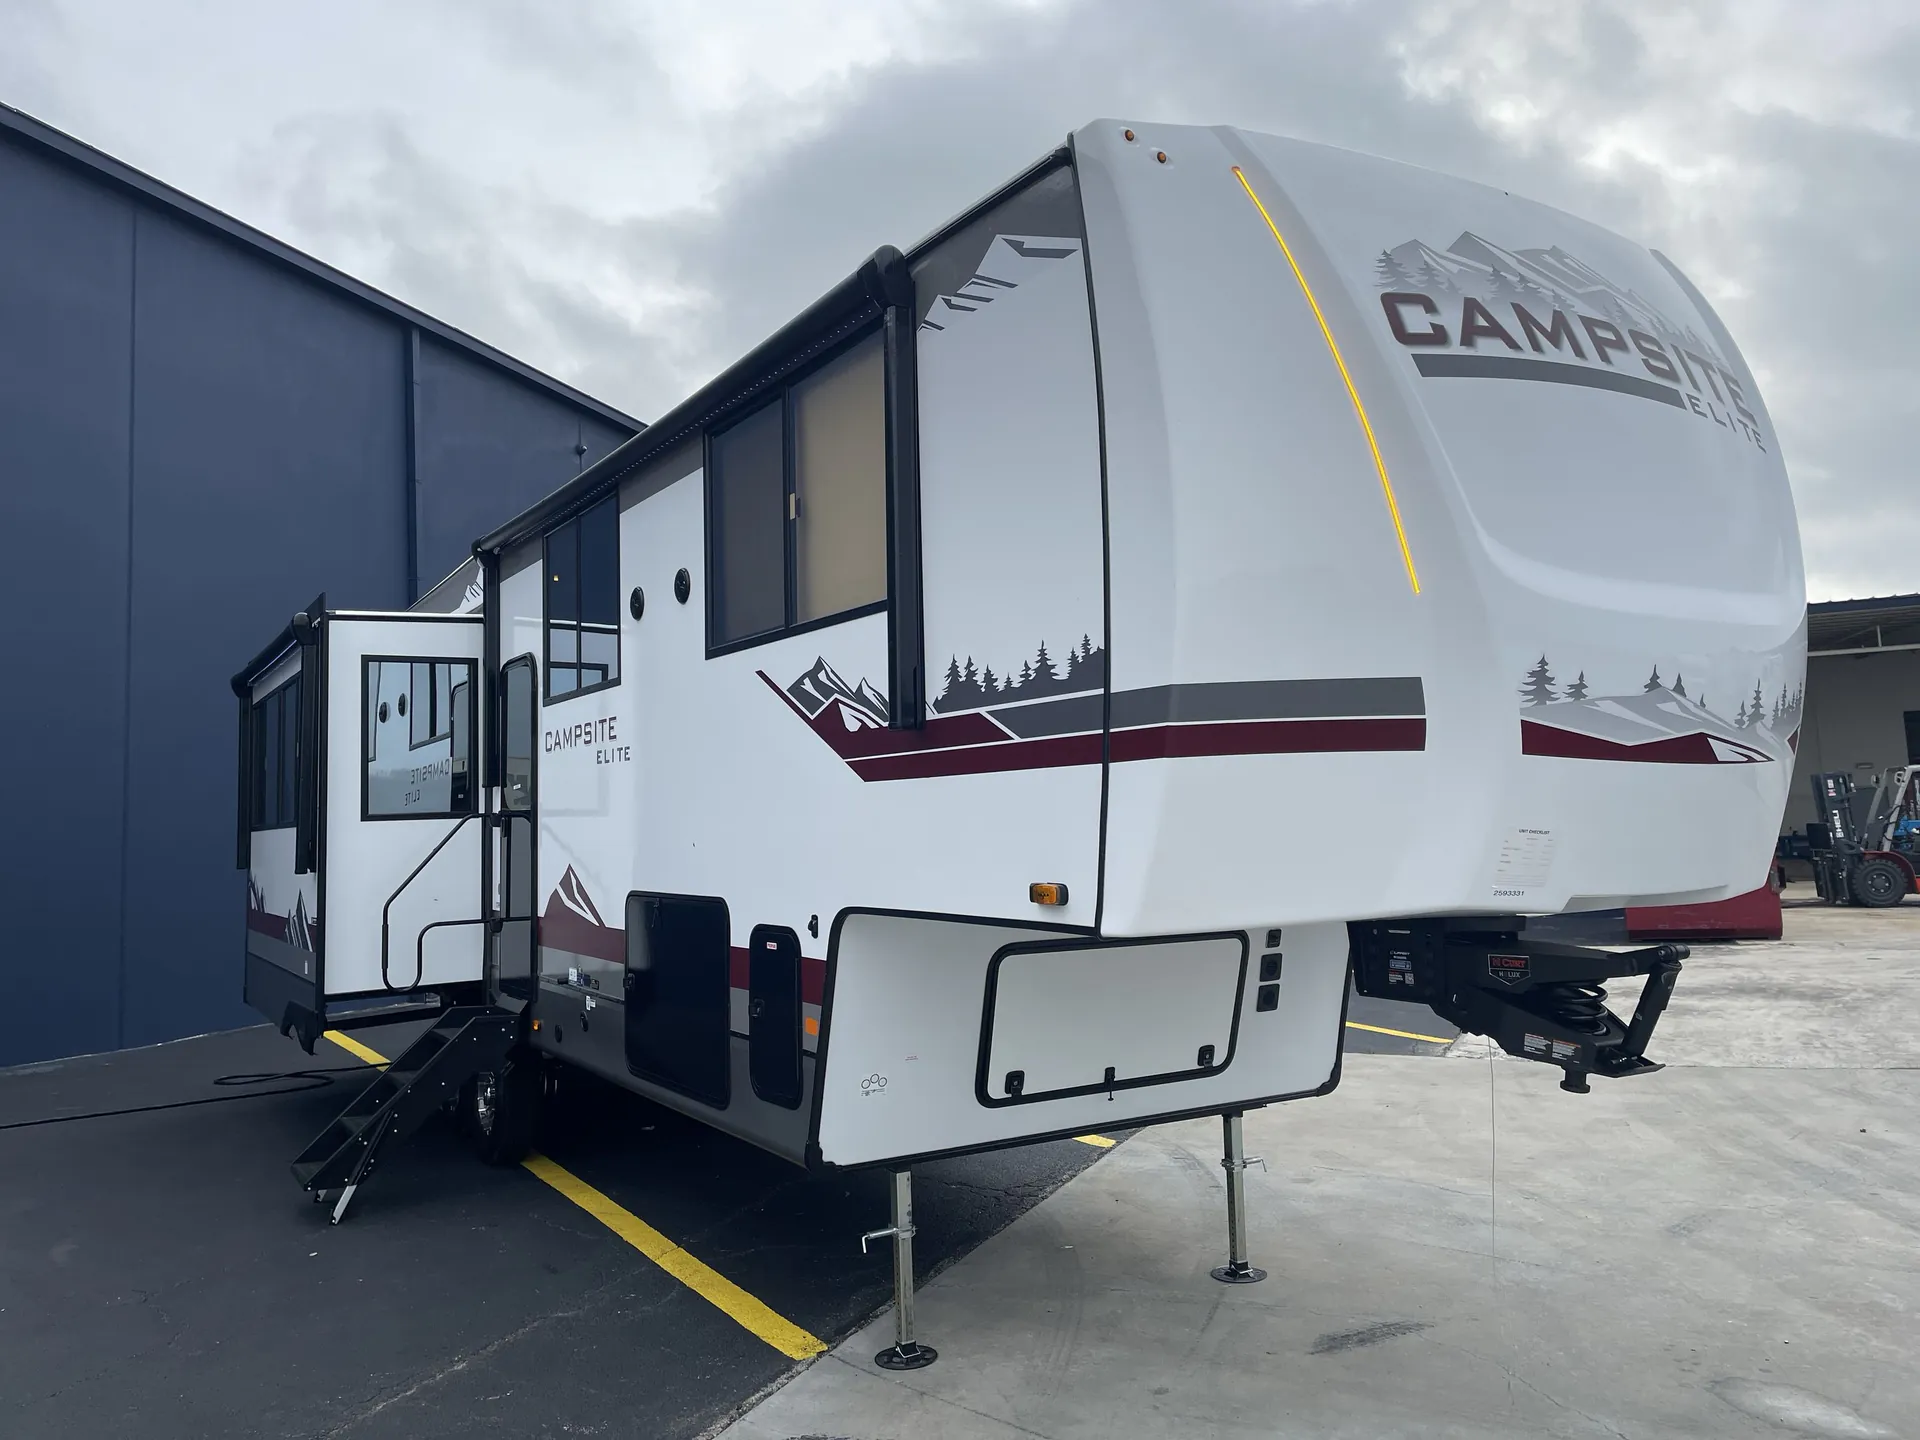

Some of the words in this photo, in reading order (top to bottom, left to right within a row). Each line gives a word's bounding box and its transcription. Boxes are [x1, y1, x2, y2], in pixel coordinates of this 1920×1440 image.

[1380, 292, 1759, 428] CAMPSITE
[1685, 393, 1767, 454] ELITE
[545, 716, 617, 753] CAMPSITE
[596, 746, 631, 765] ELITE
